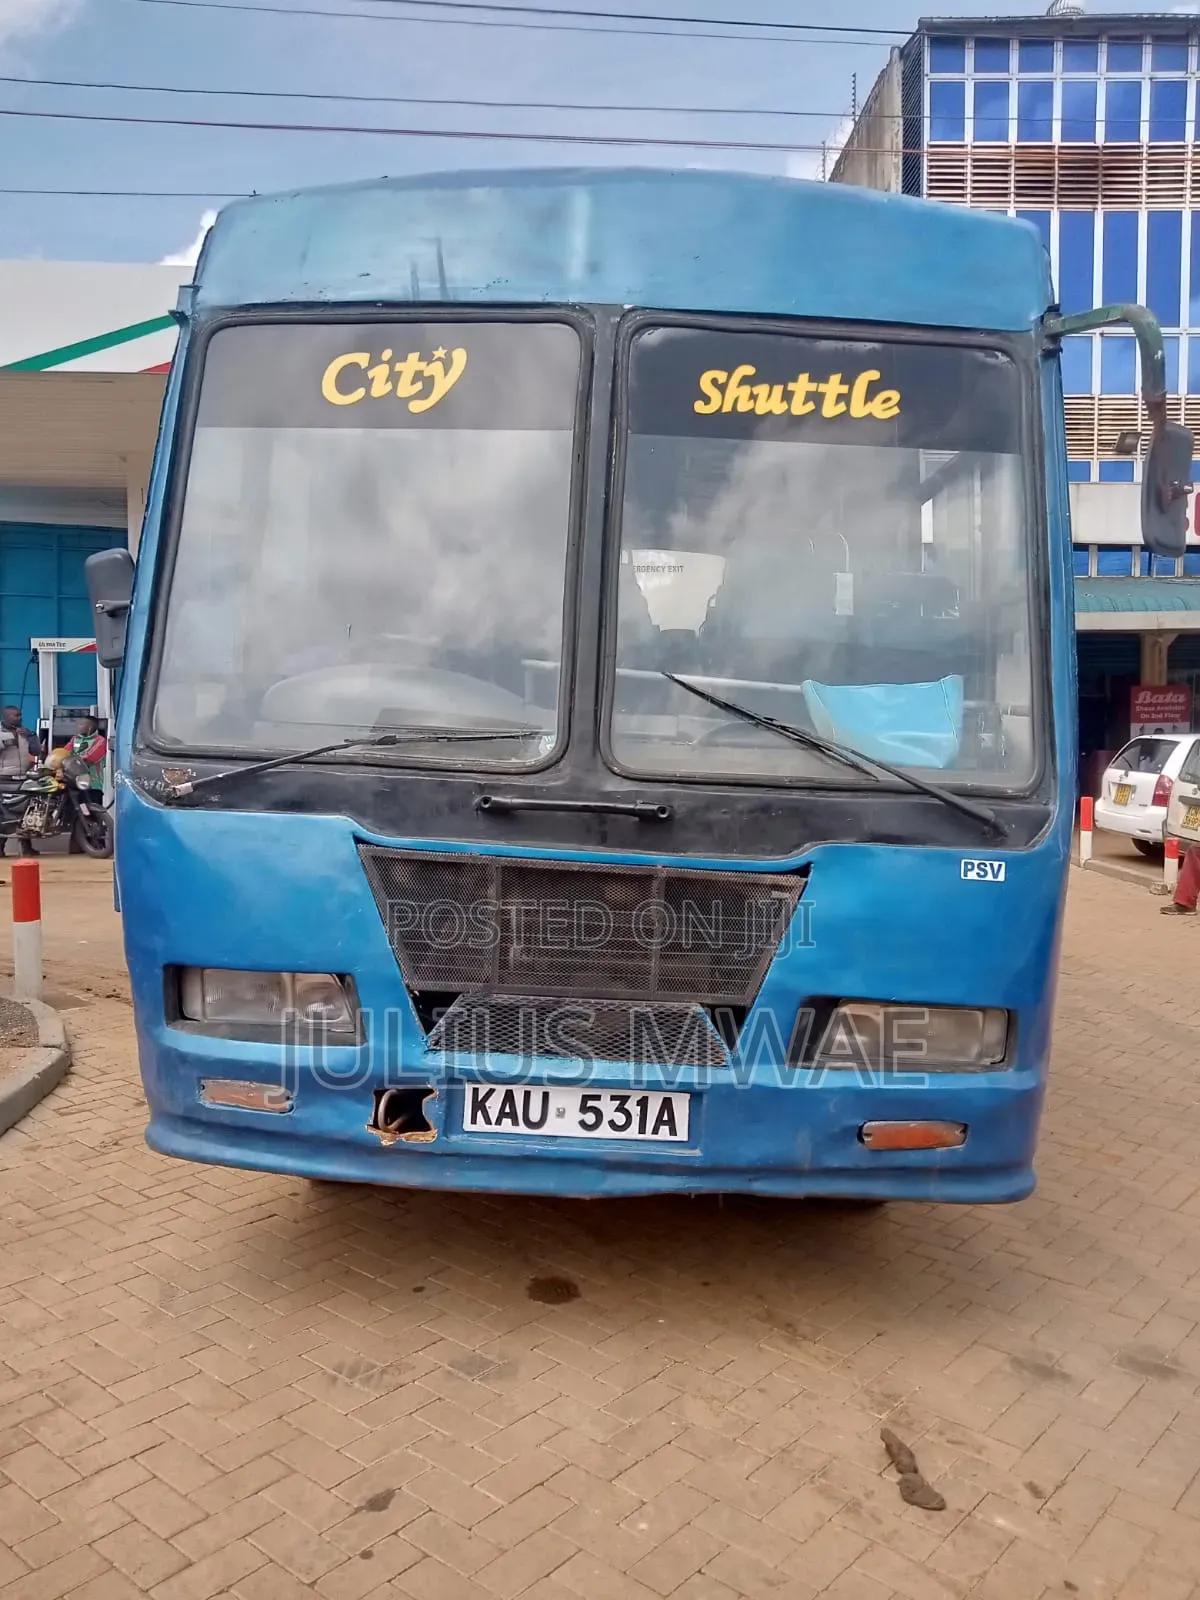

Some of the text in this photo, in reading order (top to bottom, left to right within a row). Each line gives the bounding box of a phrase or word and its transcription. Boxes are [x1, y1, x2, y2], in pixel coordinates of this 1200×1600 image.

[322, 348, 901, 419] City Shuttle
[667, 565, 684, 573] EXIT
[1134, 690, 1187, 704] Bata
[963, 861, 1003, 879] PSV
[470, 1087, 678, 1137] KAU 531A
